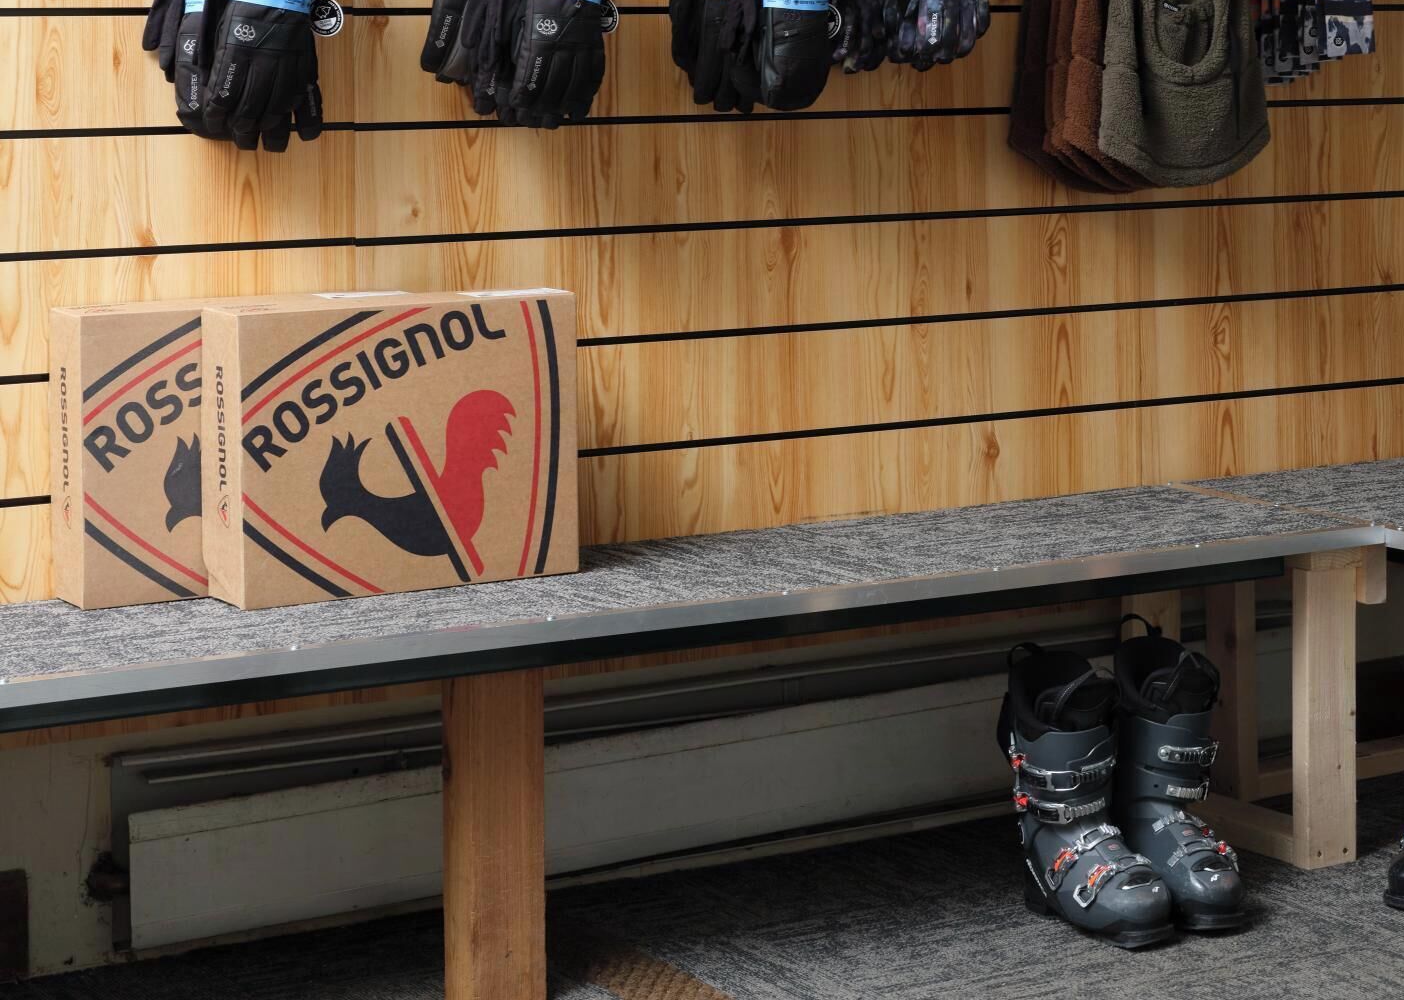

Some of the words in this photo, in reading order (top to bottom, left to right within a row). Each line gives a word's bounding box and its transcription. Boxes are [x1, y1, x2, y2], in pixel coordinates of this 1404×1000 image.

[233, 23, 256, 42] 686
[439, 15, 453, 41] GORE-TEX
[536, 18, 558, 36] 686
[224, 62, 237, 89] GORE-TEX
[531, 56, 543, 83] GORE-TEX
[190, 73, 198, 100] GORE-TEX
[241, 304, 507, 473] ROSSIGNOL
[60, 366, 71, 492] ROSSIGNOL
[215, 365, 229, 492] ROSSIGNOL
